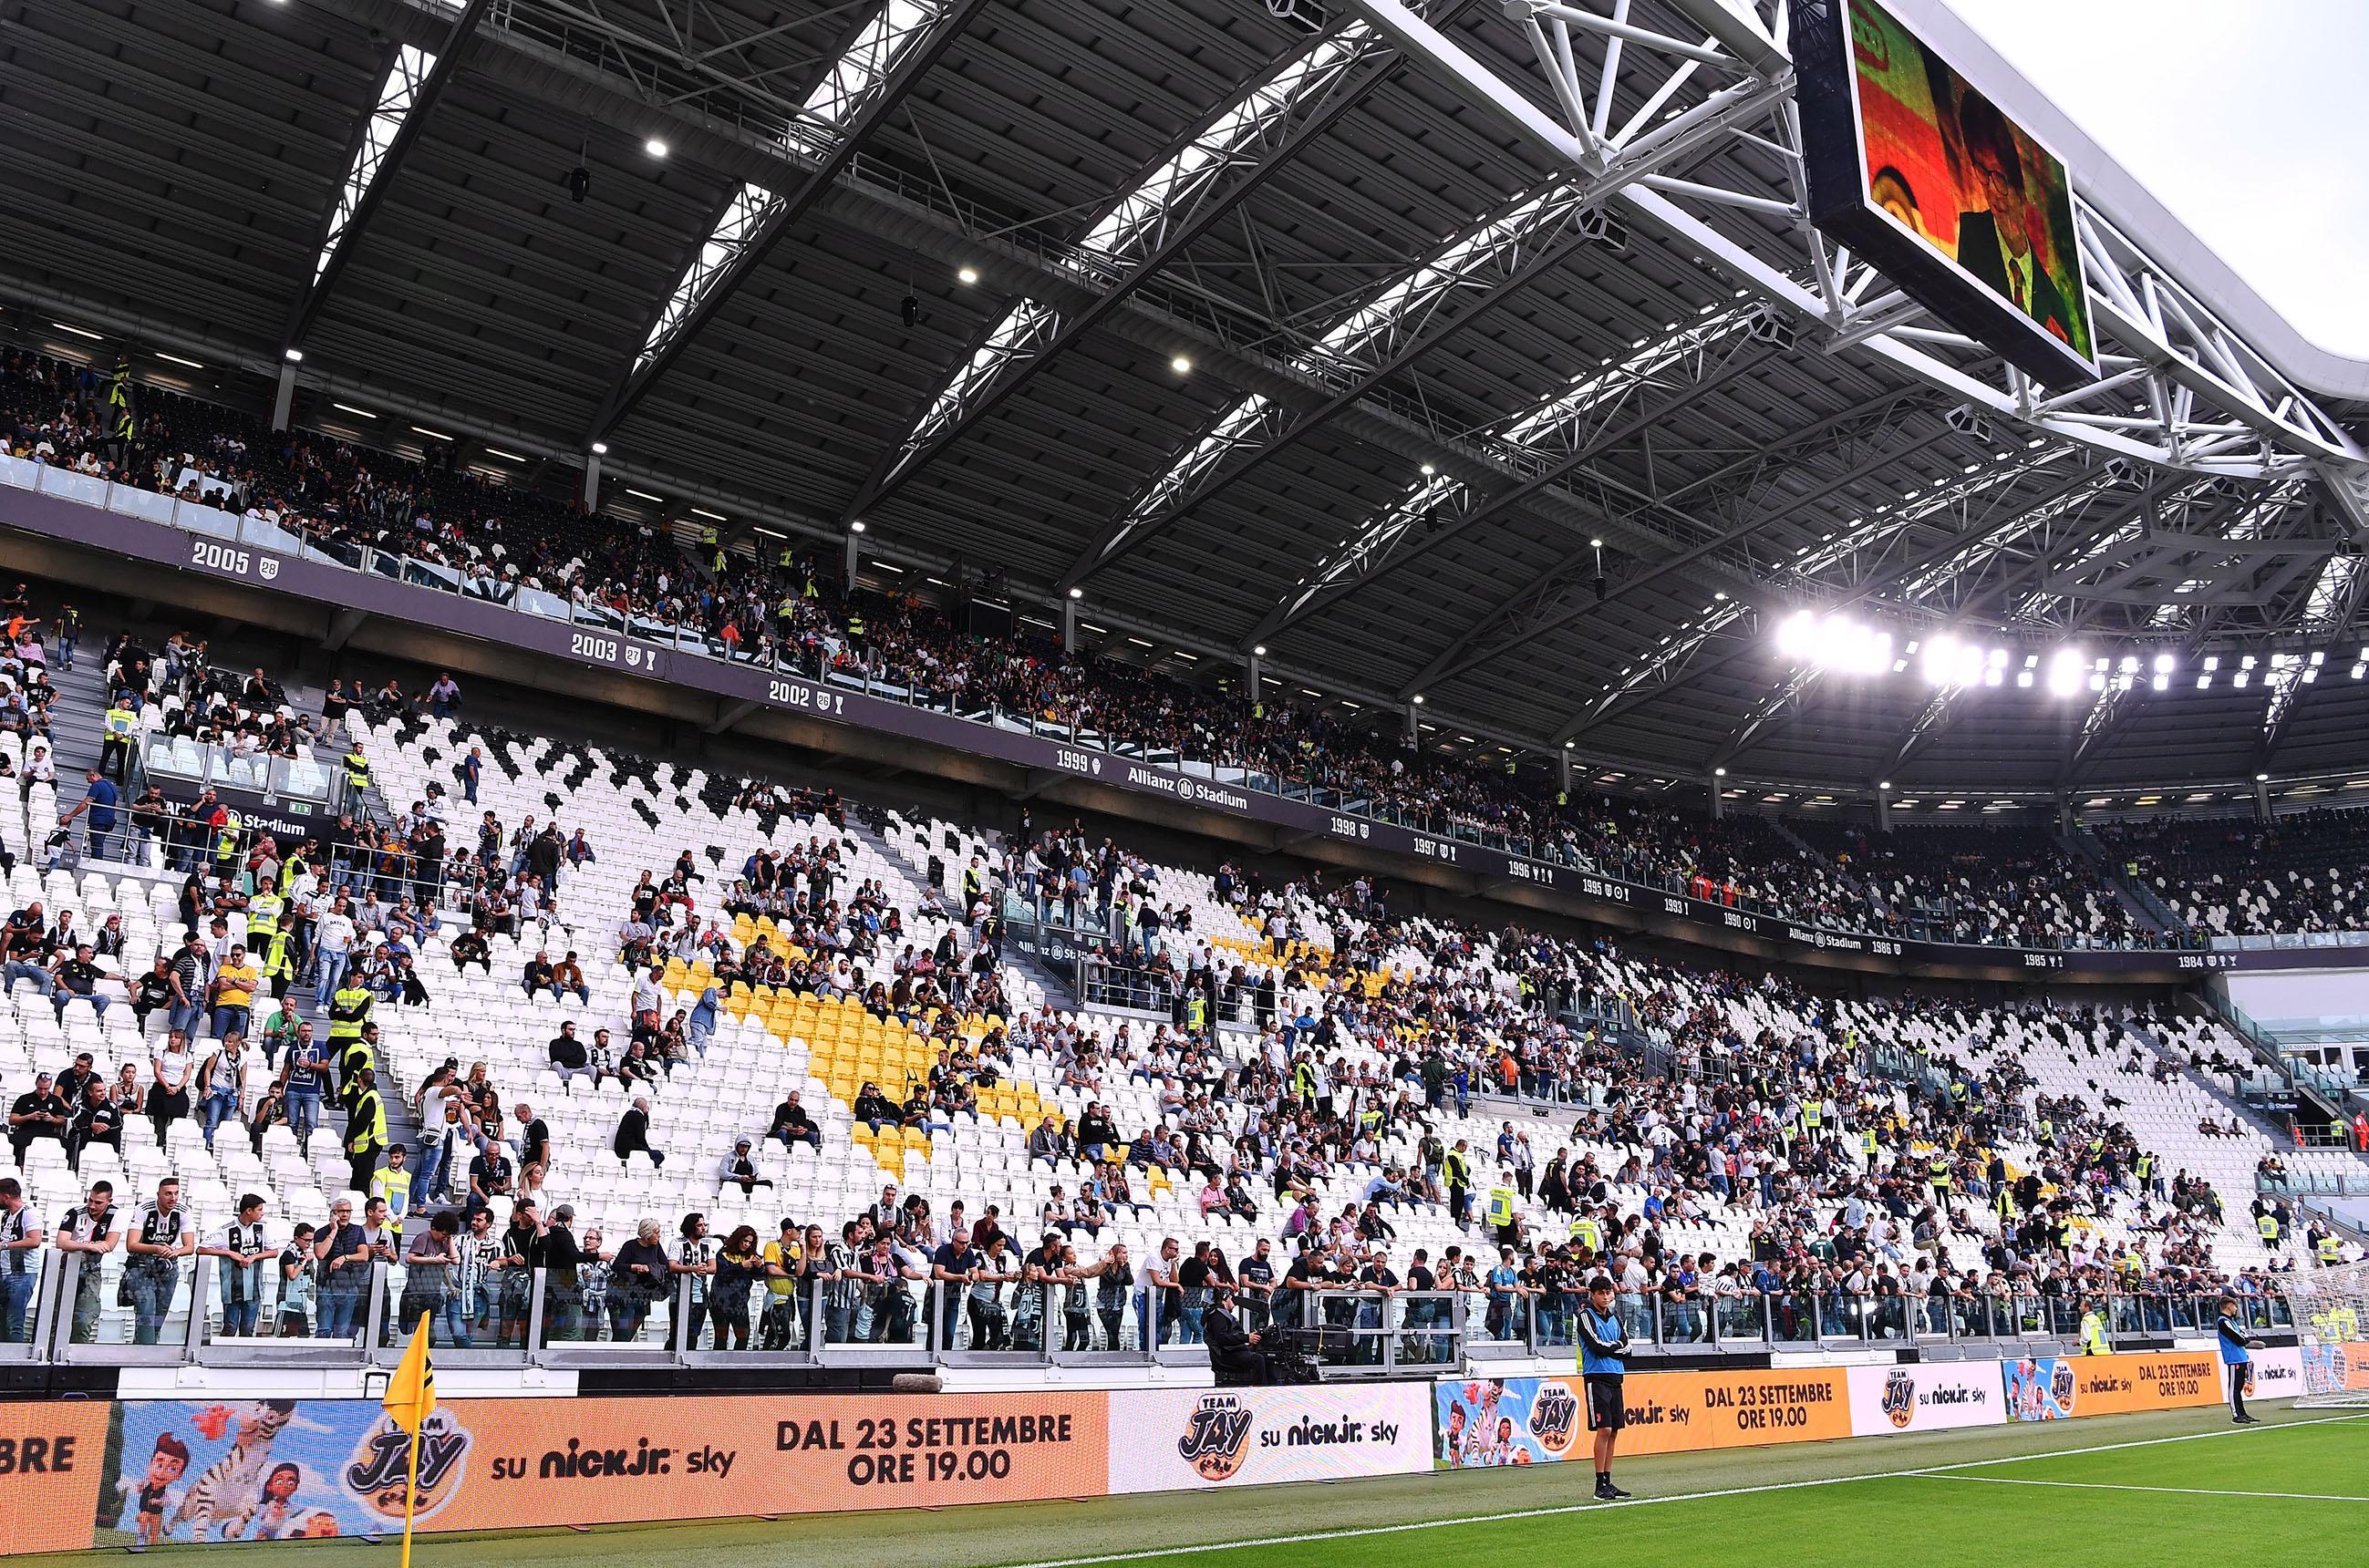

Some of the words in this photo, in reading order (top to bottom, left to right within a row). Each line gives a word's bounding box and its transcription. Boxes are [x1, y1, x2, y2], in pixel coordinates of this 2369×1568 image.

[192, 542, 250, 574] 2005
[262, 562, 276, 574] 28
[572, 634, 617, 662] 2003
[627, 649, 638, 661] 27
[769, 681, 810, 707] 2002
[818, 696, 829, 707] 26
[1057, 749, 1088, 772] 1999
[1128, 768, 1174, 792] Allianz
[1195, 785, 1247, 810] Stadium
[243, 813, 305, 836] Stadium
[1331, 817, 1356, 837] 1998
[1413, 838, 1436, 856] 1997
[1508, 861, 1530, 879] 1996
[1583, 878, 1602, 896] 1995
[1664, 898, 1682, 914] 1993
[988, 923, 996, 935] 7
[1723, 912, 1742, 928] 1990
[1789, 928, 1814, 944] Allianz
[1826, 935, 1861, 949] Stadium
[1872, 941, 1891, 954] 1986
[2024, 954, 2046, 966] 1985
[2178, 955, 2204, 967] 1984
[1252, 1114, 1260, 1126] 7
[1660, 1131, 1667, 1143] 3
[149, 1233, 173, 1243] Jeep
[1817, 1245, 1826, 1260] 1
[1890, 1371, 1907, 1379] TEAM
[2139, 1366, 2157, 1380] DAL
[2158, 1366, 2169, 1379] 23
[2171, 1363, 2211, 1379] SETTEMBRE
[1544, 1388, 1566, 1397] TEAM
[1705, 1387, 1734, 1408] DAL
[1737, 1386, 1756, 1406] 23
[1760, 1382, 1833, 1404] SETTEMBRE
[2052, 1372, 2074, 1399] JAY
[2121, 1380, 2133, 1393] sky
[2158, 1382, 2176, 1397] ORE
[2177, 1380, 2198, 1396] 19.00
[1203, 1398, 1236, 1408] TEAM
[1881, 1378, 1915, 1414] JAY
[1919, 1394, 1929, 1405] su
[1972, 1387, 1986, 1405] sky
[1529, 1398, 1578, 1436] JAY
[1670, 1404, 1690, 1426] sky
[1737, 1408, 1766, 1429] ORE
[1770, 1406, 1807, 1428] 19.00
[777, 1419, 845, 1451] DAL
[857, 1418, 897, 1449] 23
[906, 1414, 1071, 1446] SETTEMBRE
[1178, 1409, 1254, 1461] JAY
[1260, 1429, 1280, 1448] su
[1371, 1418, 1399, 1446] sky
[347, 1431, 467, 1493] JAY
[491, 1457, 526, 1480] su
[687, 1445, 736, 1479] sky
[848, 1454, 913, 1486] ORE
[926, 1449, 1010, 1482] 19.00
